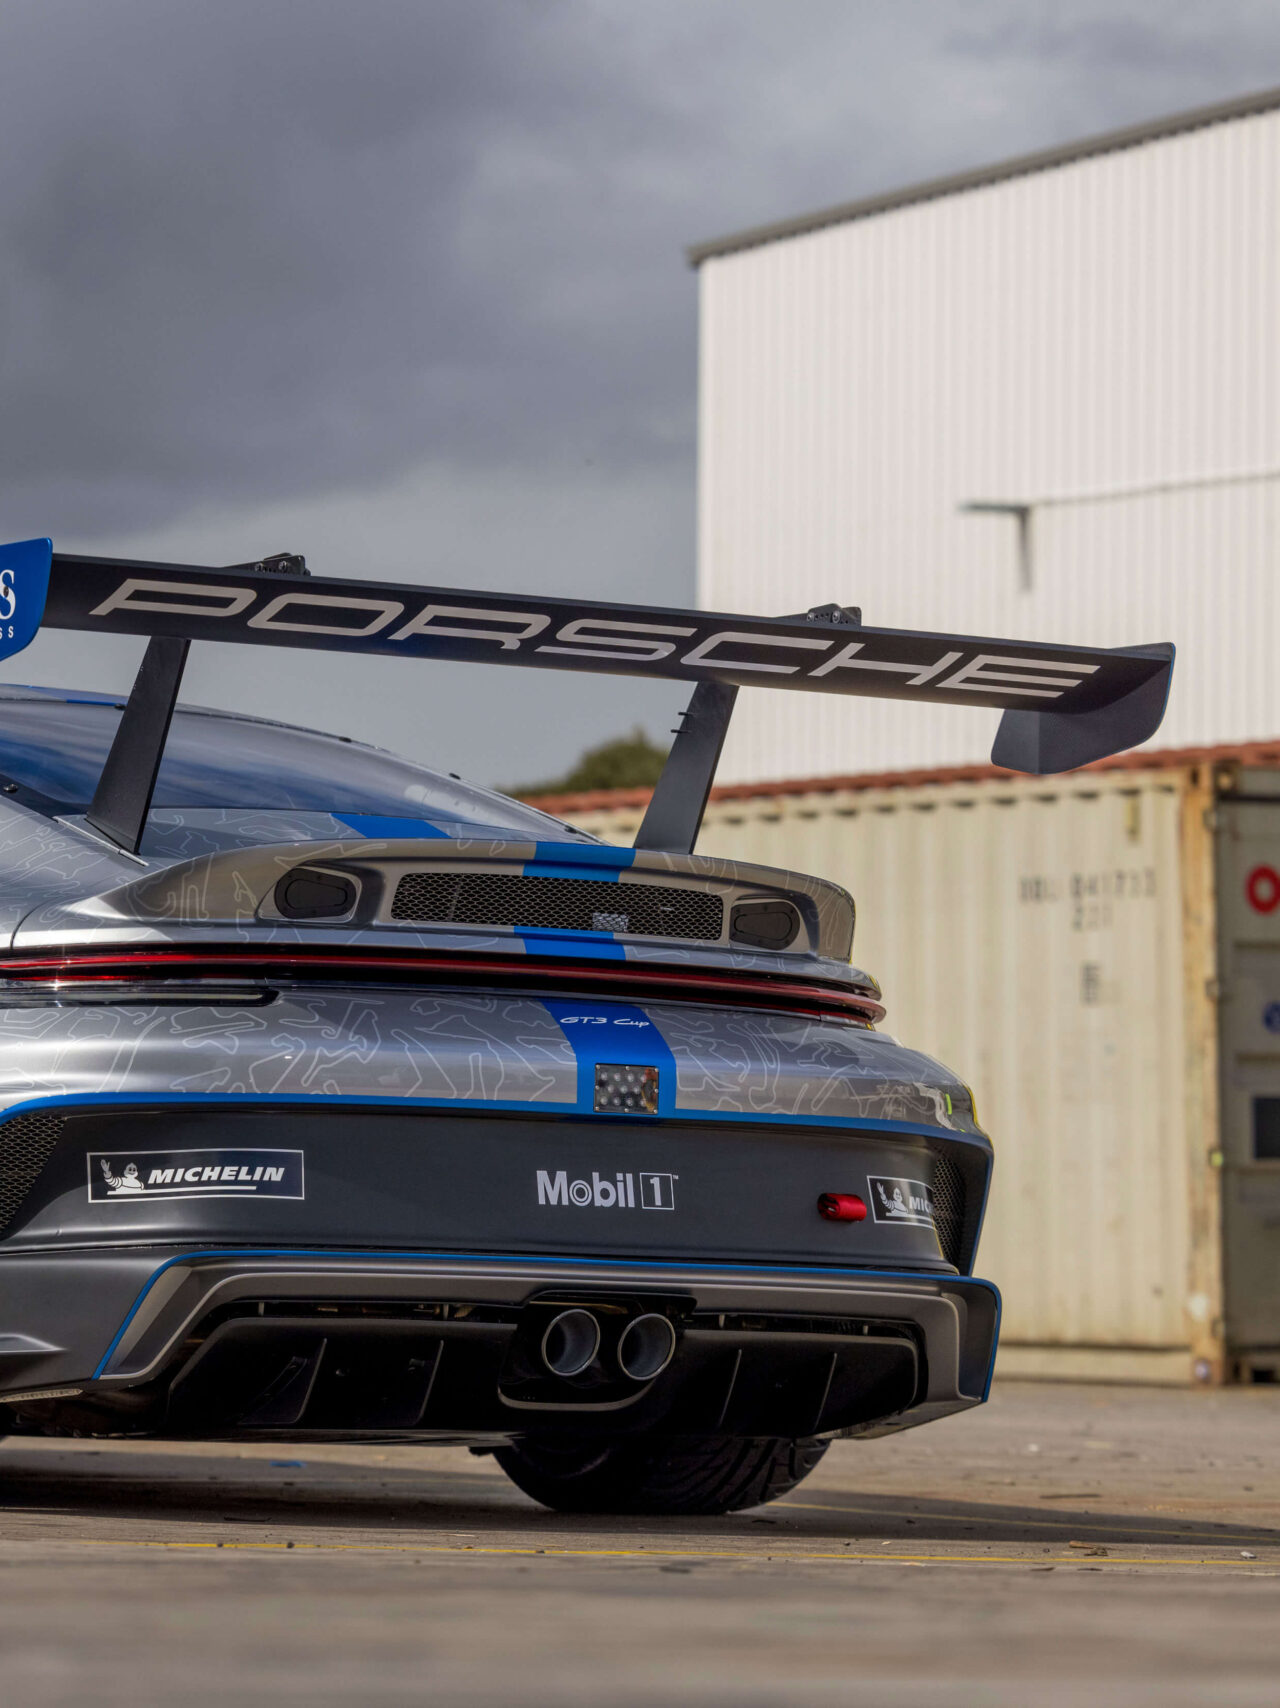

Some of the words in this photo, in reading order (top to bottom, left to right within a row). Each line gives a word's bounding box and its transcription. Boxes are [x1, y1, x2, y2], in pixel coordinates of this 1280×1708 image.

[88, 578, 1102, 699] PORSCHE
[560, 1015, 608, 1025] GT3
[613, 1017, 650, 1029] Cup
[146, 1165, 286, 1185] MICHELIN
[535, 1169, 636, 1209] Mobil
